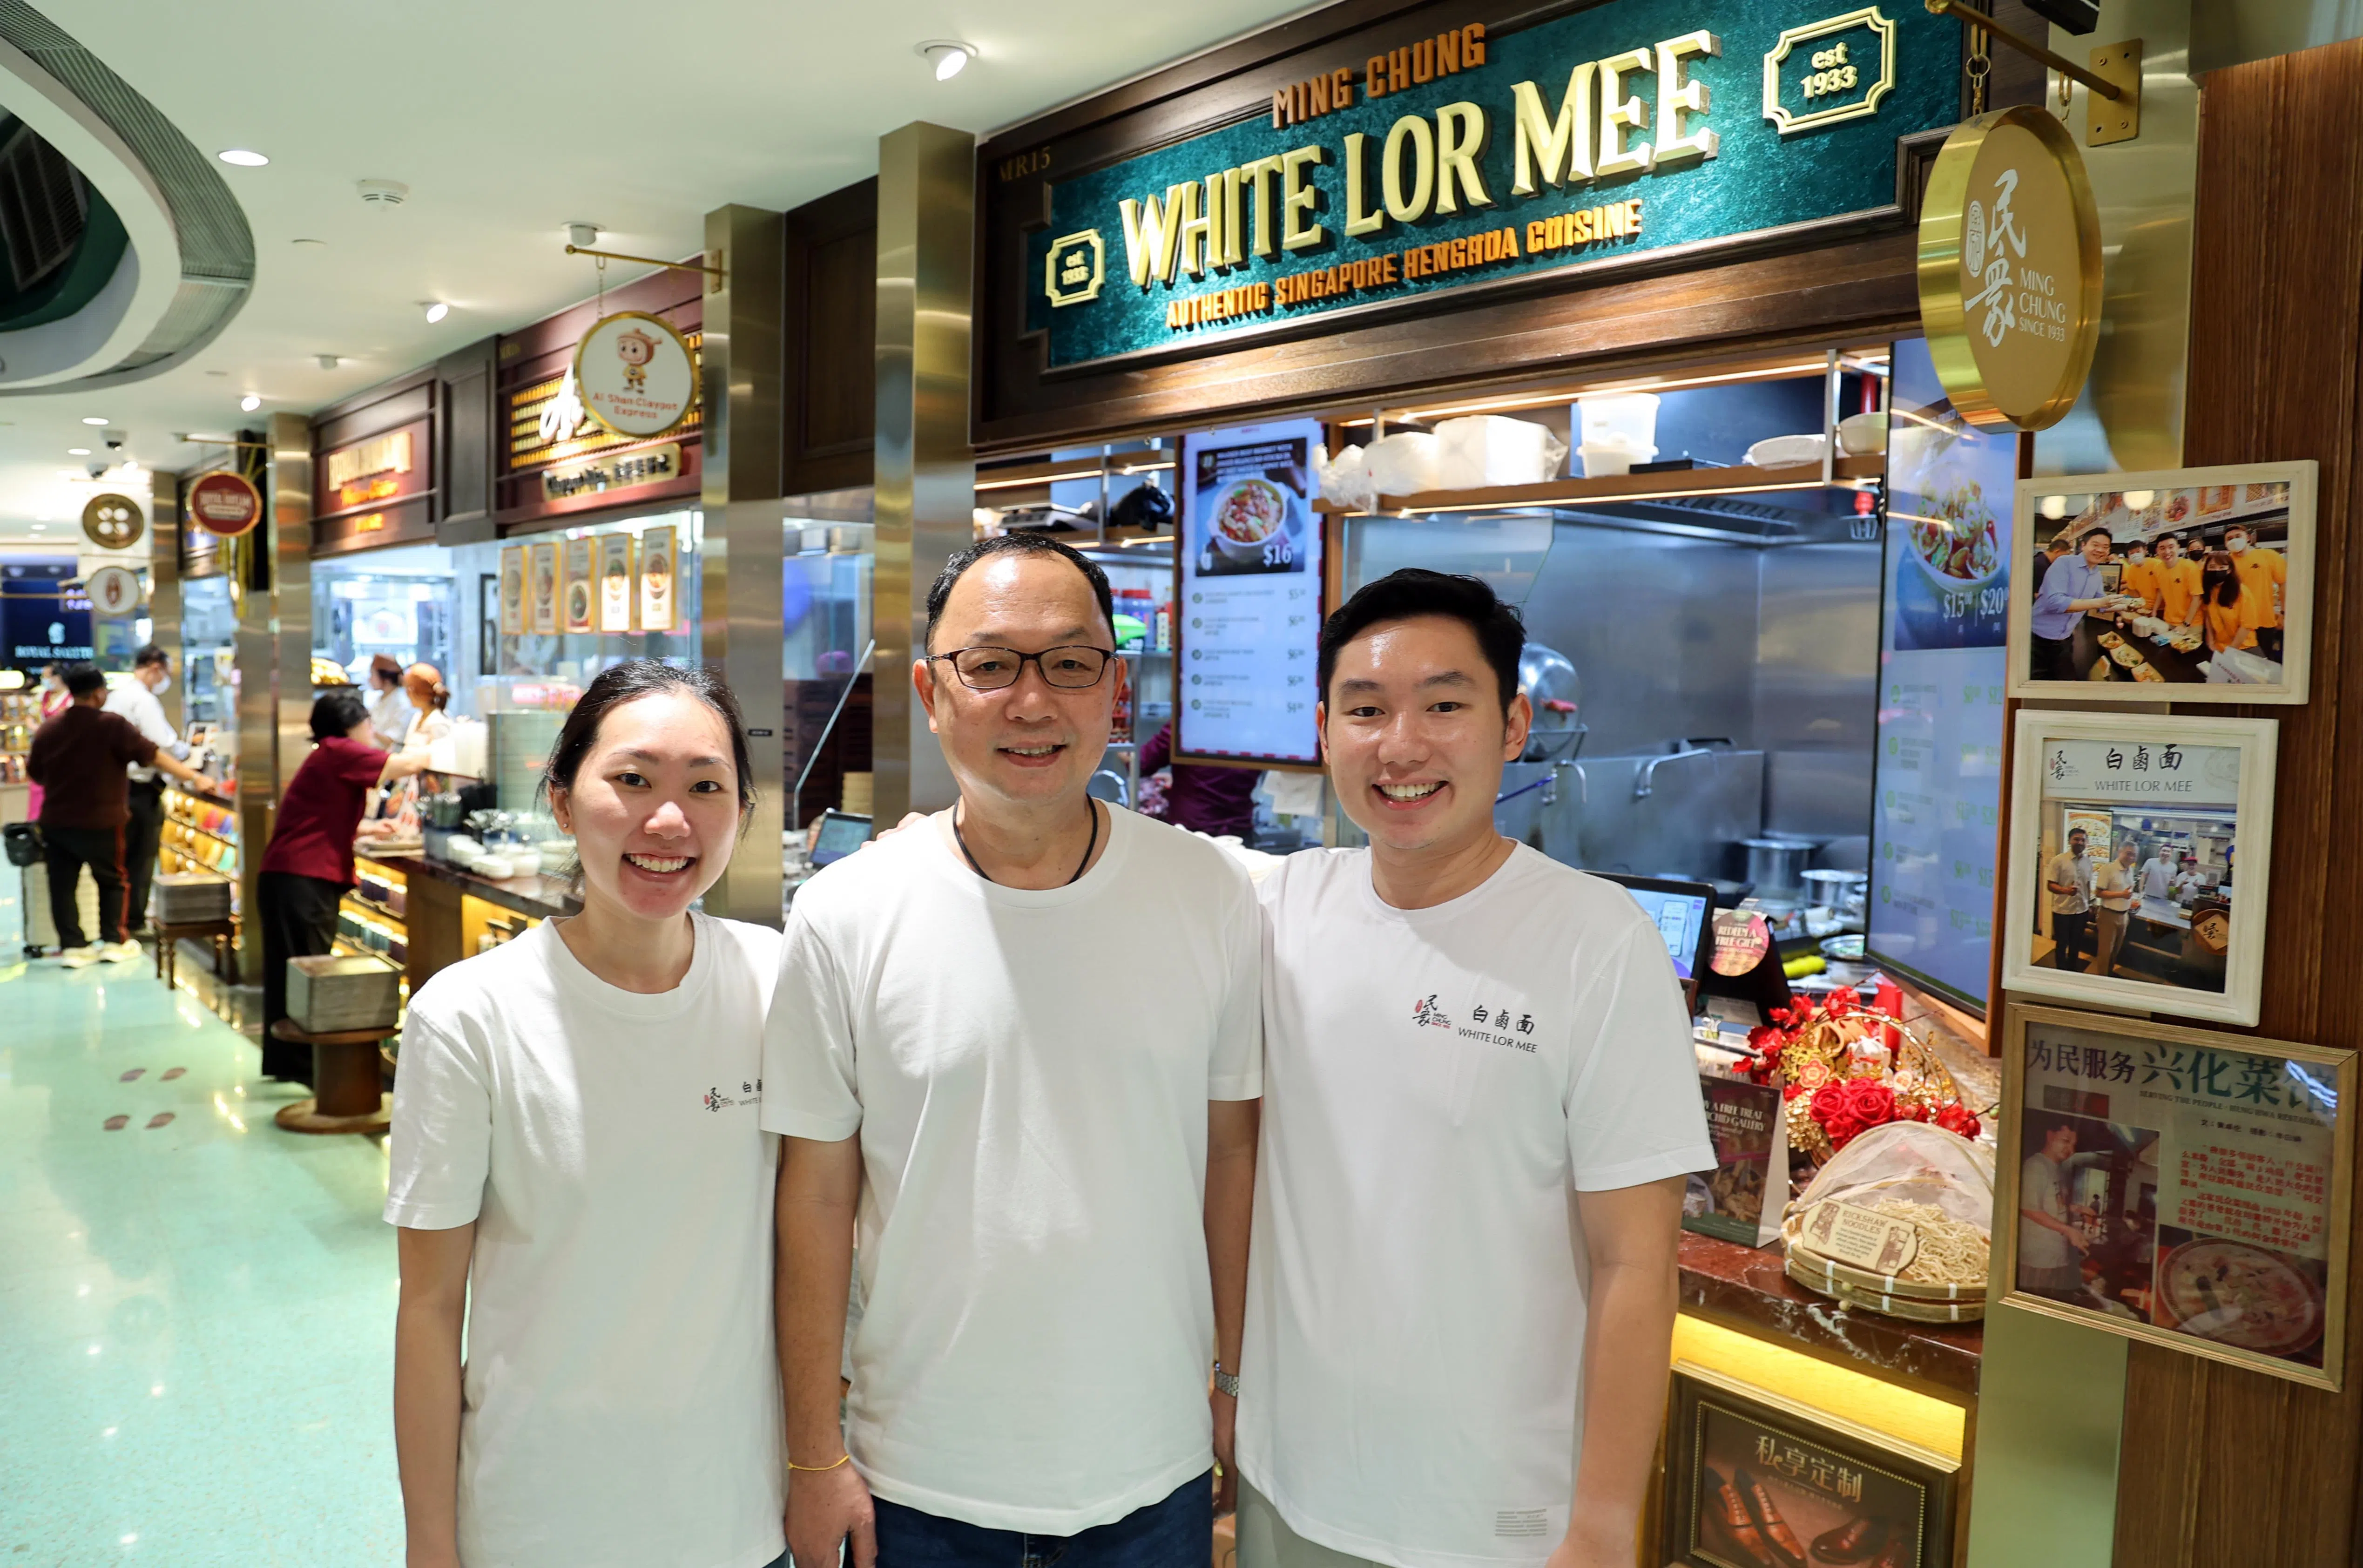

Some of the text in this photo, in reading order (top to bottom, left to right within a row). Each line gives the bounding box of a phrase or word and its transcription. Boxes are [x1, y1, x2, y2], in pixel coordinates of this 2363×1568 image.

[1811, 42, 1848, 69] est
[1272, 22, 1485, 129] MING CHUNG
[1800, 66, 1858, 98] 1933
[1000, 146, 1050, 182] MR15
[1119, 29, 1715, 287] WHITE LOR MEE
[1166, 198, 1643, 328] AUTHENTIC SINGAPORE HENGHUA CUISINE
[2020, 267, 2054, 296] MING
[2019, 292, 2066, 323] CHUNG
[2019, 317, 2065, 341] SINCE 1933
[608, 394, 633, 405] Shan
[636, 397, 677, 410] Claypot
[614, 405, 658, 419] Express
[1263, 544, 1292, 568] $16
[2095, 780, 2193, 792] WHITE LOR MEE
[1715, 935, 1735, 946] FREE
[1458, 1027, 1538, 1053] WHITE LOR MEE
[2028, 1040, 2135, 1084] 为民服务
[738, 1097, 758, 1106] WHITE
[2174, 1095, 2191, 1105] THE
[2192, 1099, 2223, 1110] PEOPLE
[1843, 1210, 1889, 1228] RICKSHAW
[1843, 1219, 1883, 1235] NOODLES
[1755, 1435, 1863, 1503] 私享定制
